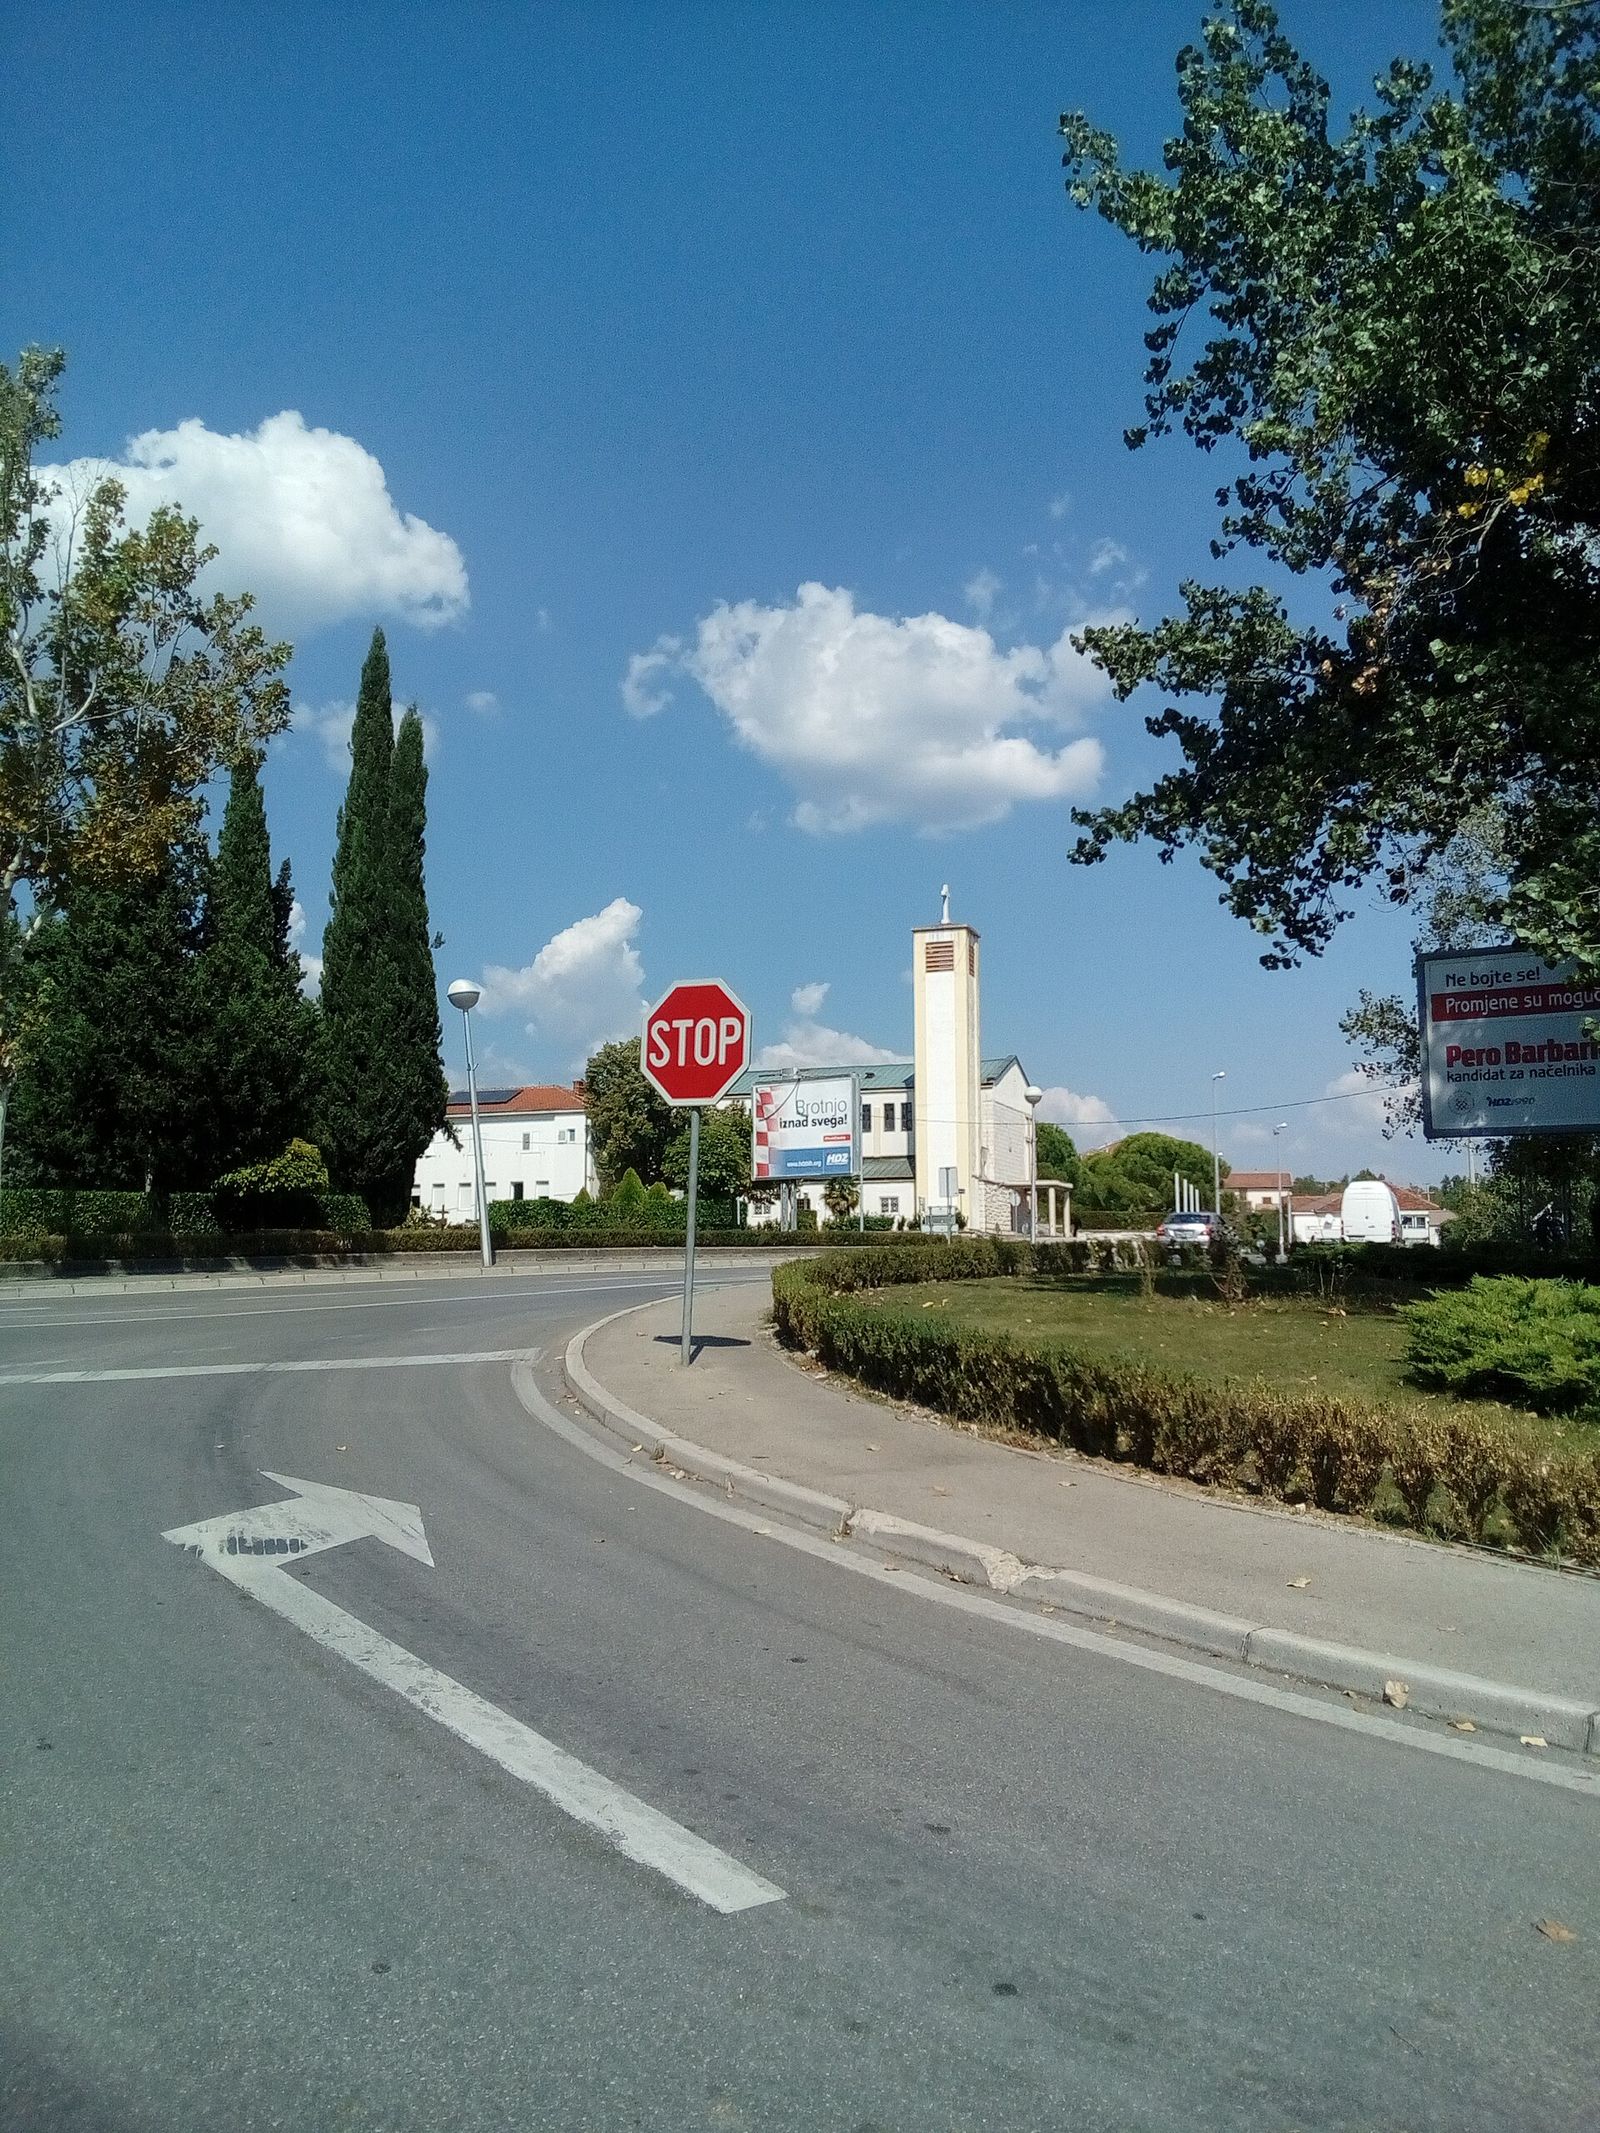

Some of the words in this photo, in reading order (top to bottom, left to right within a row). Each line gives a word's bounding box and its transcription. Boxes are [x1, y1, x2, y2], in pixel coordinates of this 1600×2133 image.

[1445, 973, 1466, 987] Ne
[1470, 970, 1512, 988] bojte
[1517, 966, 1540, 981] se!
[1445, 994, 1519, 1015] Promjene
[1523, 995, 1542, 1007] su
[649, 1017, 742, 1068] STOP
[1446, 1045, 1500, 1068] Pero
[1504, 1039, 1600, 1064] Barbari
[1447, 1069, 1506, 1083] kandidat
[1509, 1069, 1525, 1080] za
[1529, 1063, 1596, 1079] načelnika
[795, 1097, 847, 1117] Brotnjo
[779, 1115, 809, 1129] iznad
[811, 1113, 848, 1129] svega!
